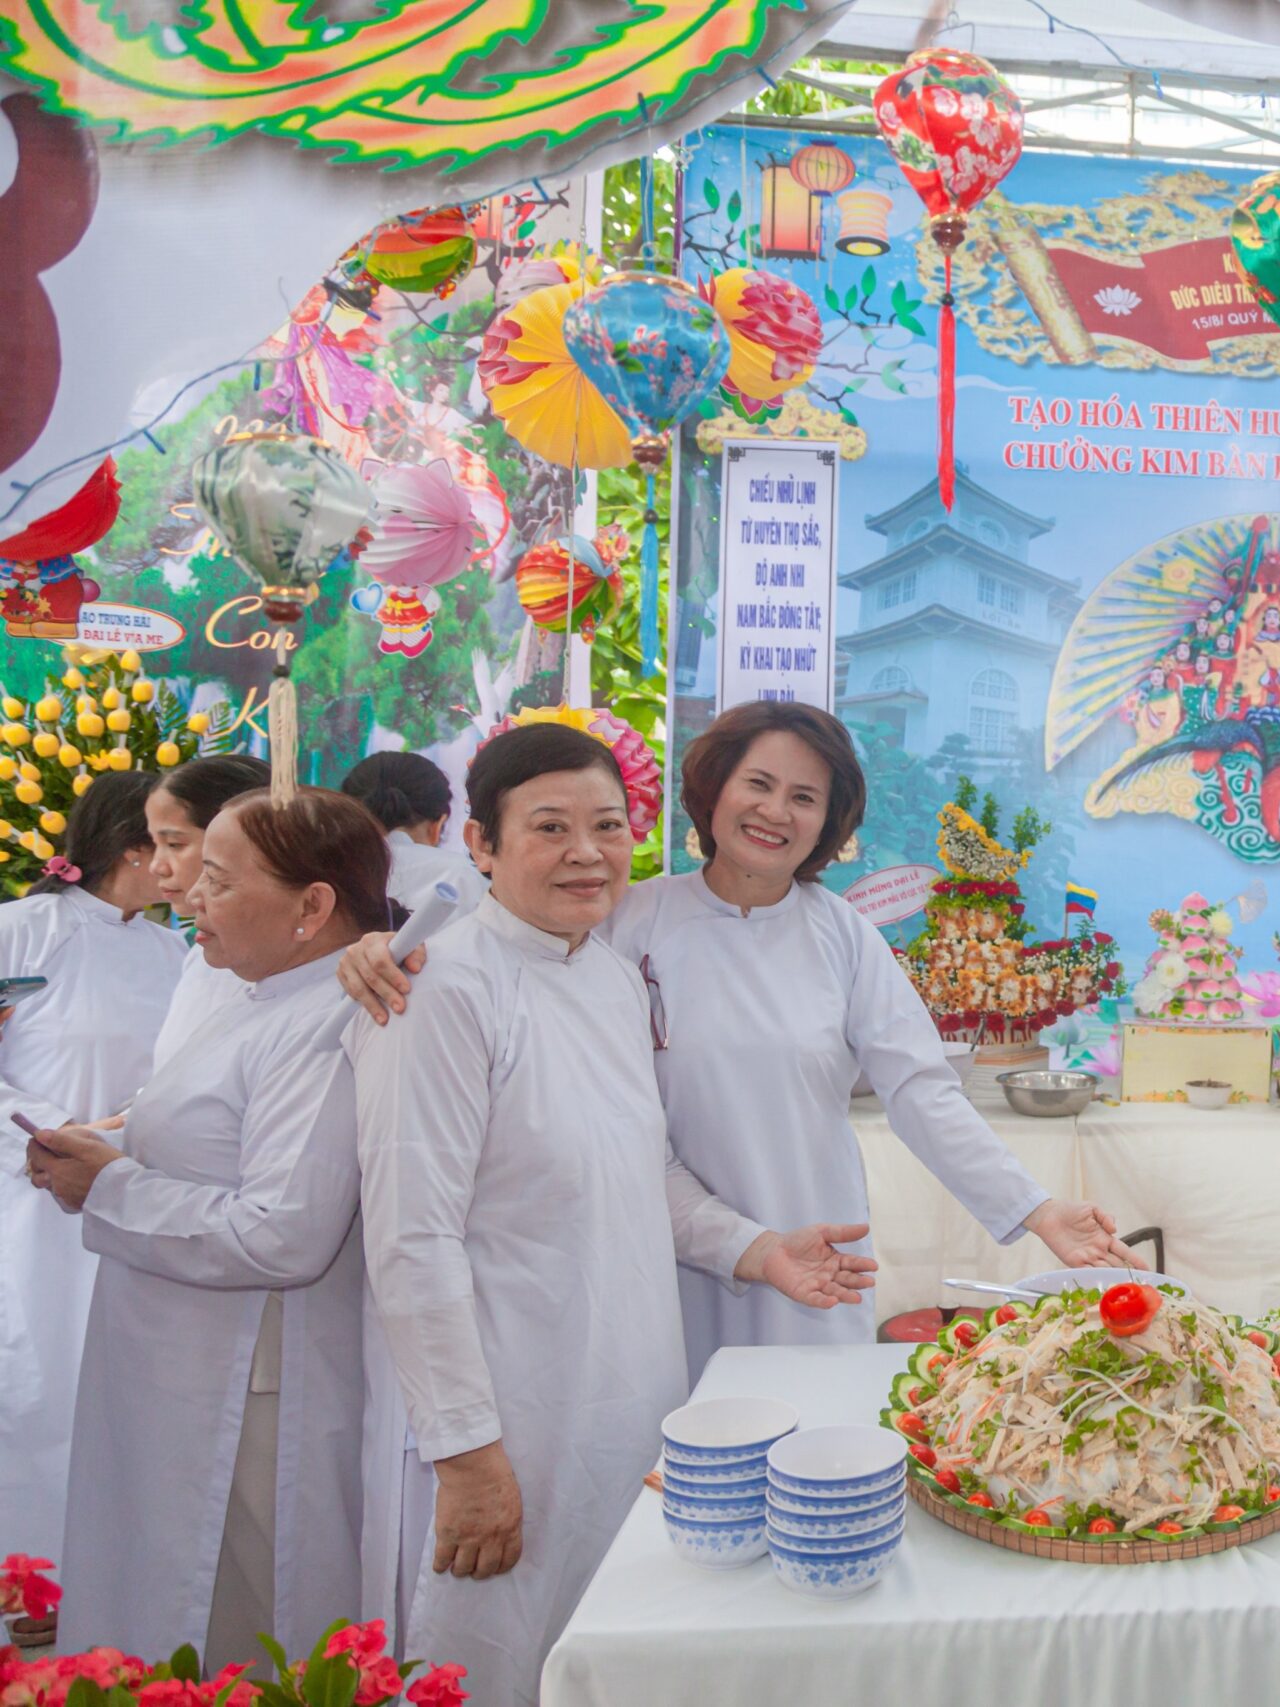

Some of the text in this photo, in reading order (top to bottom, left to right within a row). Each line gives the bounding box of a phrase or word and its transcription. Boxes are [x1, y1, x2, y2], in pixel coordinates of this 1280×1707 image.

[1234, 283, 1256, 304] TR
[1008, 396, 1073, 431] TẠO
[1078, 394, 1144, 430] HÓA
[1151, 400, 1242, 434] THIÊN
[1003, 436, 1133, 474] CHƯỞNG
[1140, 446, 1202, 477] KIM
[1207, 444, 1266, 479] BÀN
[769, 563, 787, 588] ANH
[790, 564, 805, 588] NHI
[205, 595, 298, 650] Con
[737, 603, 757, 629] NAM
[753, 646, 773, 671] KHAI
